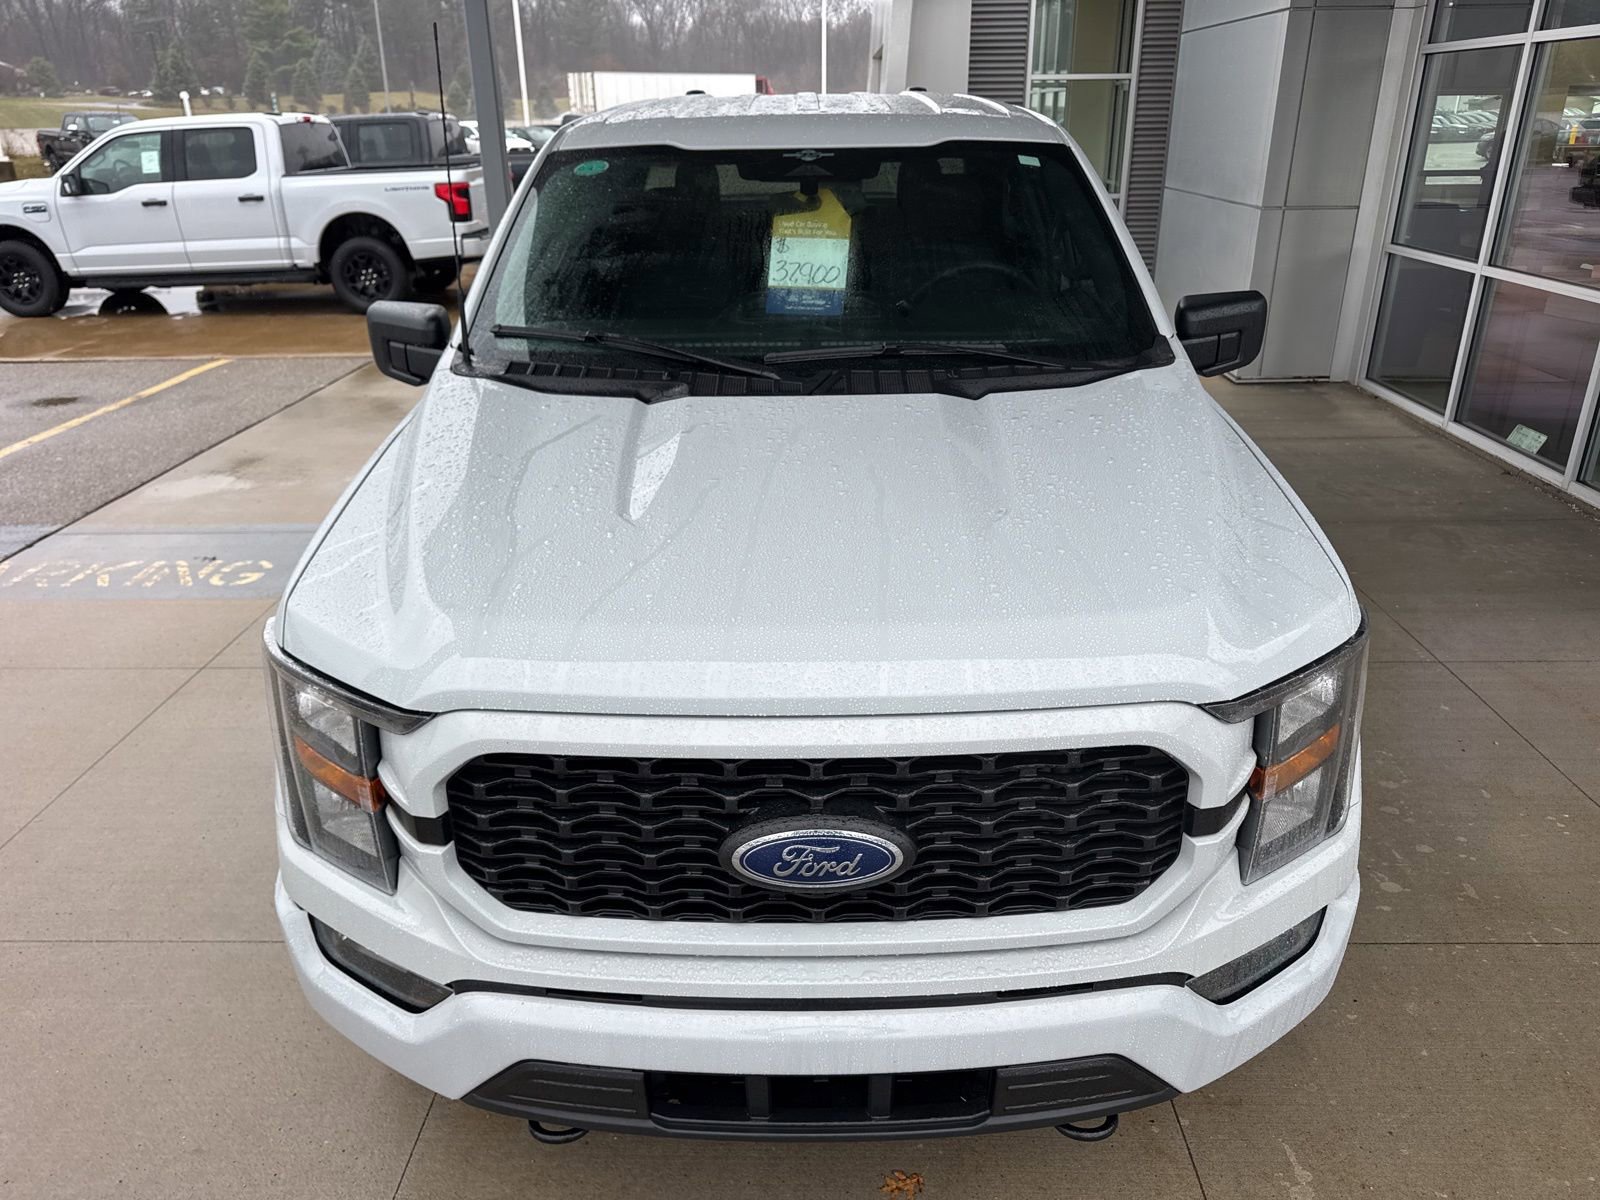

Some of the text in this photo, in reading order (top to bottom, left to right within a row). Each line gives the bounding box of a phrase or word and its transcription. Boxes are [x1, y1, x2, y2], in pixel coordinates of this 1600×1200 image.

[775, 238, 789, 253] $
[772, 260, 840, 284] 37,900
[772, 844, 863, 878] Ford
